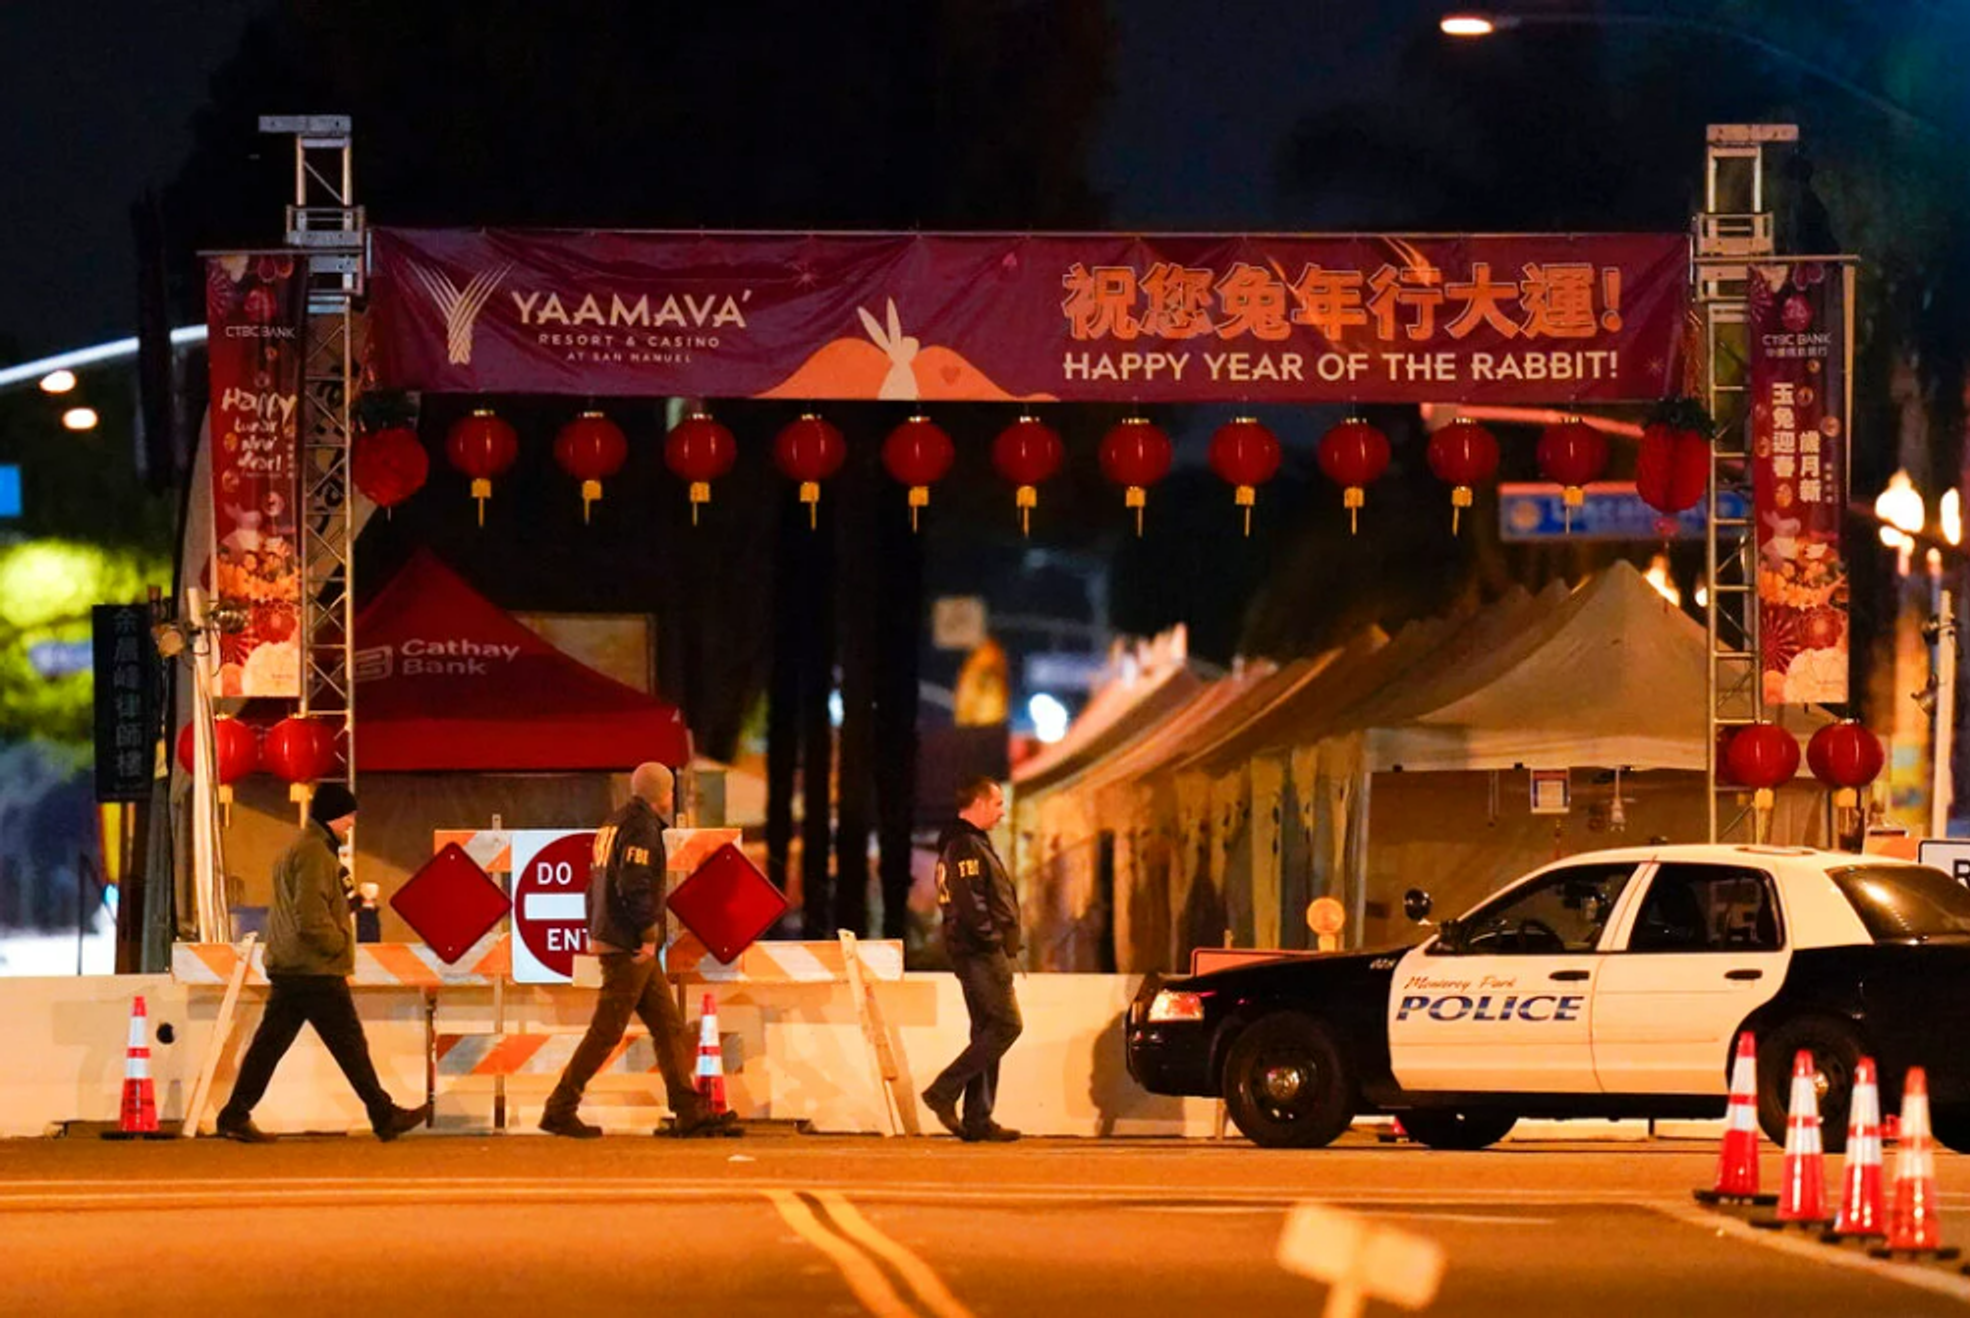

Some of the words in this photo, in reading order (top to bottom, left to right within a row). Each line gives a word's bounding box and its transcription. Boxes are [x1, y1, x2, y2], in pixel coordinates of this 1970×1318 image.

[1061, 262, 1623, 341] 祝您兔年行大運!
[538, 333, 614, 346] RESORT
[625, 335, 636, 347] &
[647, 335, 721, 348] CASINO
[566, 352, 585, 362] AT
[1063, 352, 1190, 381] HAPPY
[1203, 352, 1304, 381] YEAR
[1317, 352, 1369, 381] OF
[1381, 352, 1456, 381] THE
[1470, 351, 1618, 380] RABBIT!
[401, 639, 520, 663] Cathay
[403, 658, 488, 676] Bank
[626, 846, 650, 866] FBI
[537, 862, 572, 885] DO
[1396, 996, 1585, 1021] POLICE
